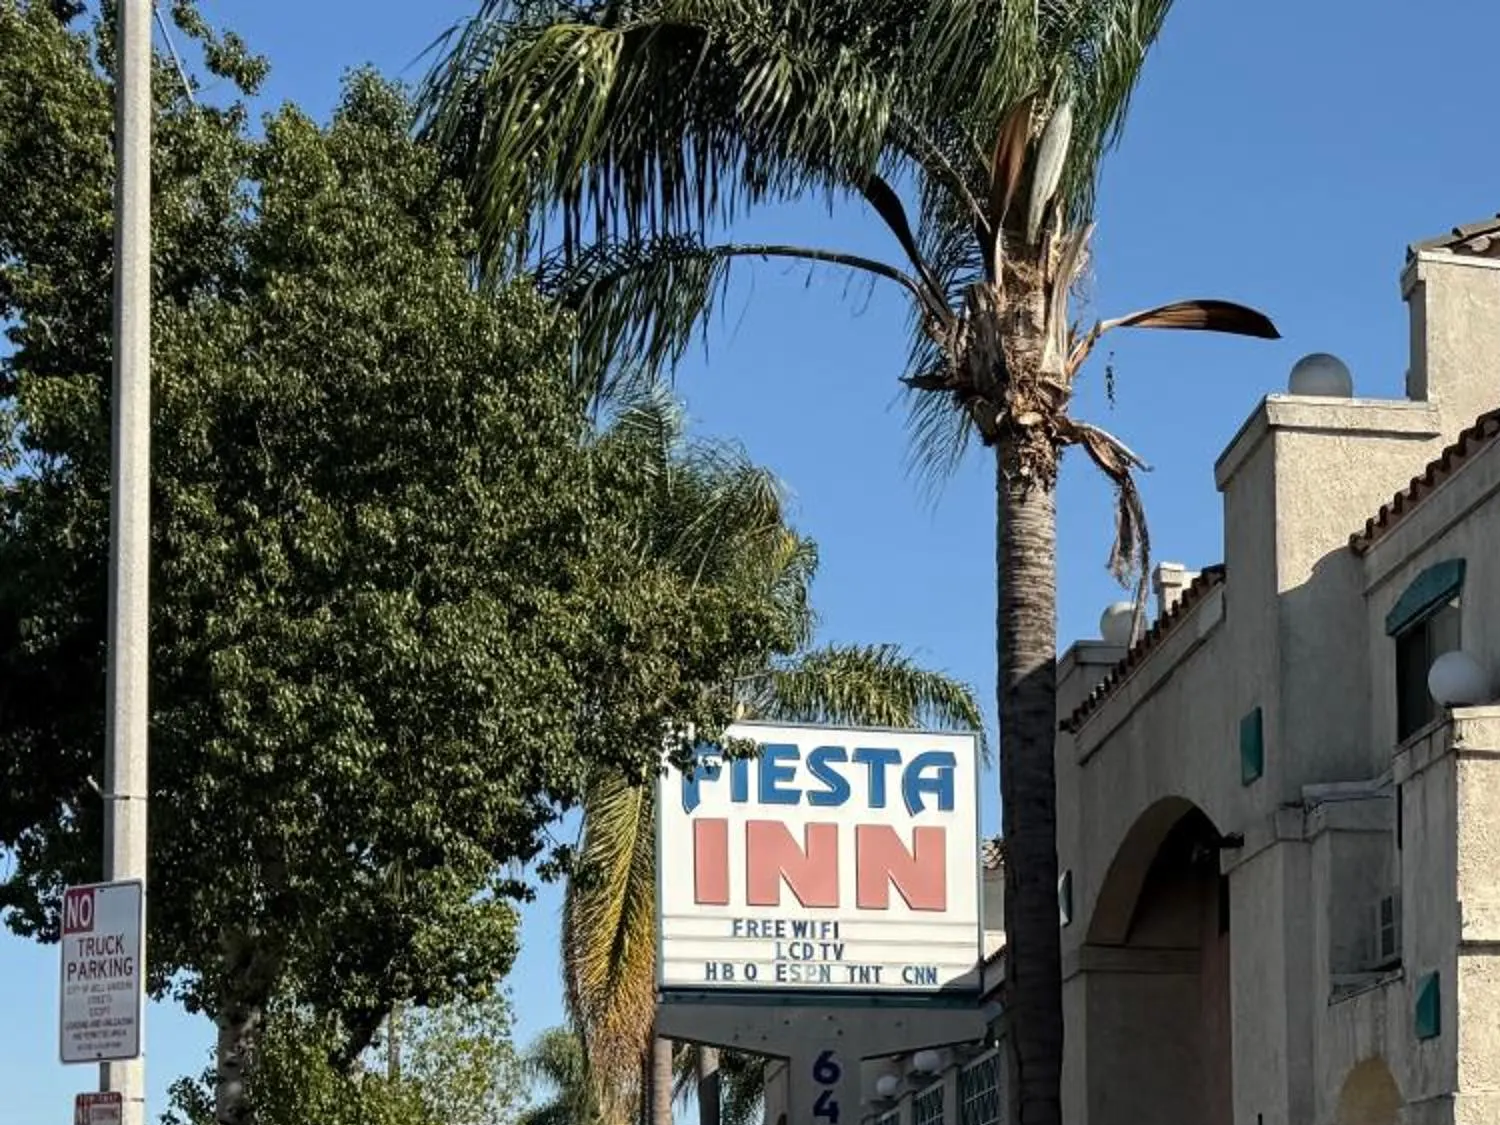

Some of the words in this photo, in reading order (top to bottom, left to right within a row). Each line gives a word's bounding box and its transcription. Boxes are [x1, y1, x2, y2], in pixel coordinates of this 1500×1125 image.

[682, 741, 957, 816] FIESTA
[693, 818, 946, 911] INN
[67, 894, 92, 929] NO
[732, 919, 785, 939] FREE
[792, 920, 840, 940] WIFI
[78, 933, 124, 957] TRUCK
[776, 942, 814, 961] LCD
[819, 943, 845, 961] TV
[67, 957, 133, 982] PARKING
[776, 964, 831, 983] ESPN
[846, 965, 883, 984] TNT
[902, 966, 937, 984] CNN
